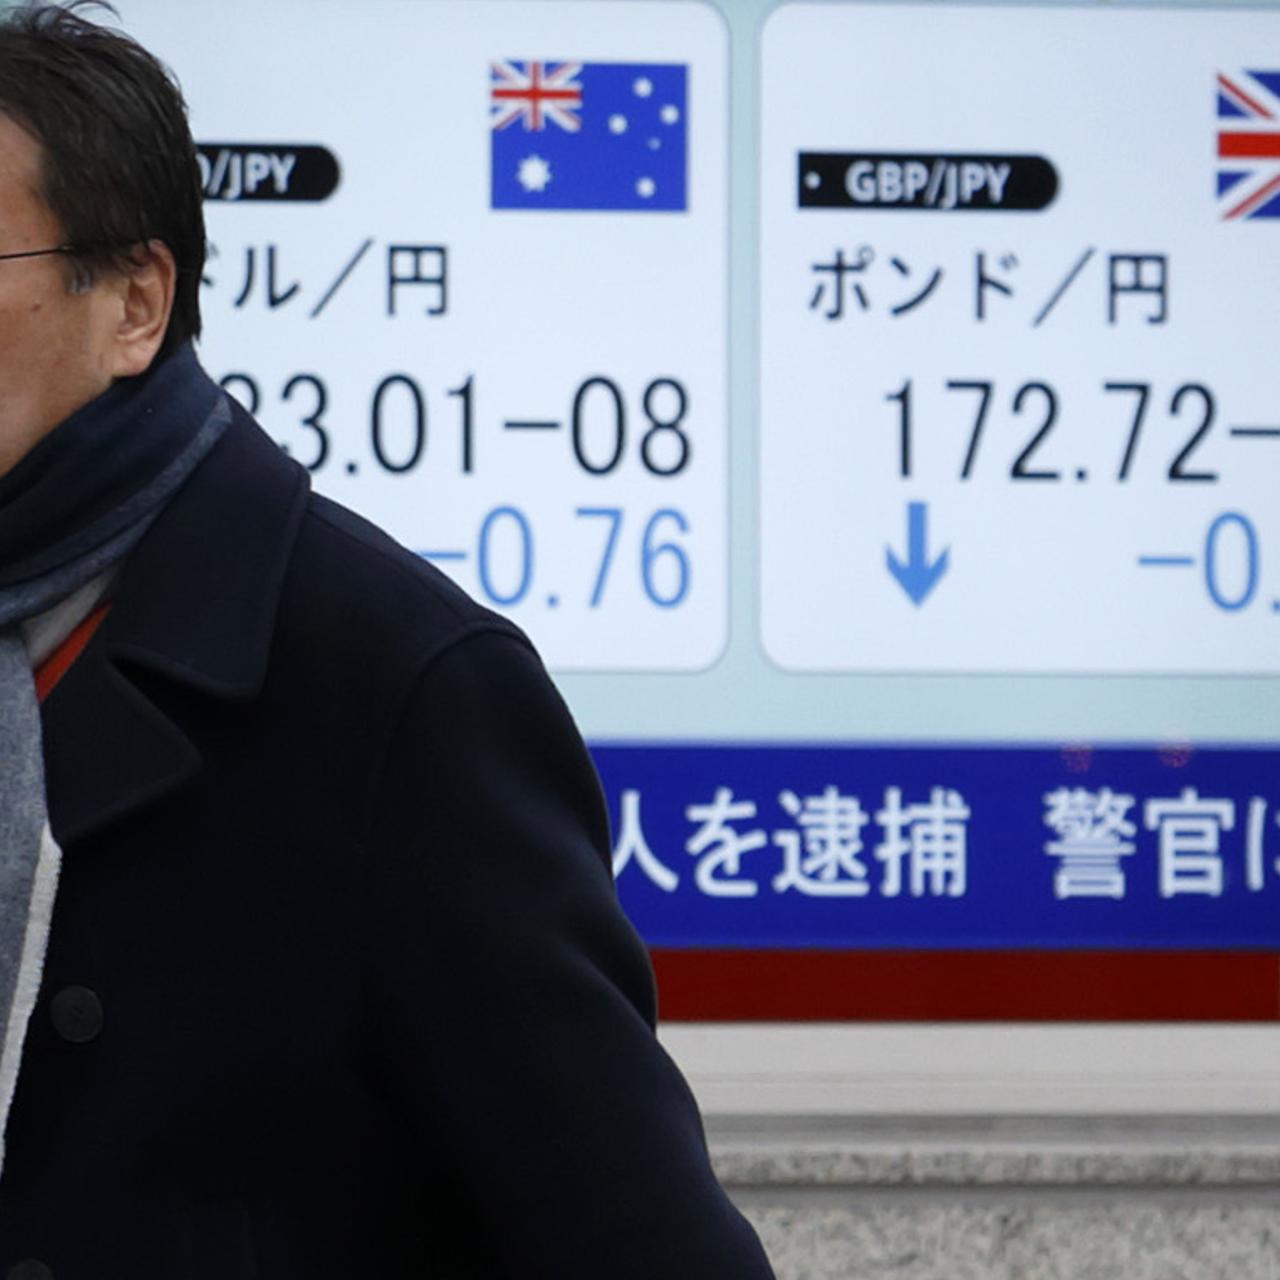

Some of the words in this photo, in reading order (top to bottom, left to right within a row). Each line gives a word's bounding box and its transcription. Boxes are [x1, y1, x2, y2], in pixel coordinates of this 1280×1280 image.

[838, 160, 1011, 212] GBP/JPY
[202, 237, 450, 318] ル／円
[809, 249, 1169, 326] ポンド／円
[416, 505, 691, 610] -0.76
